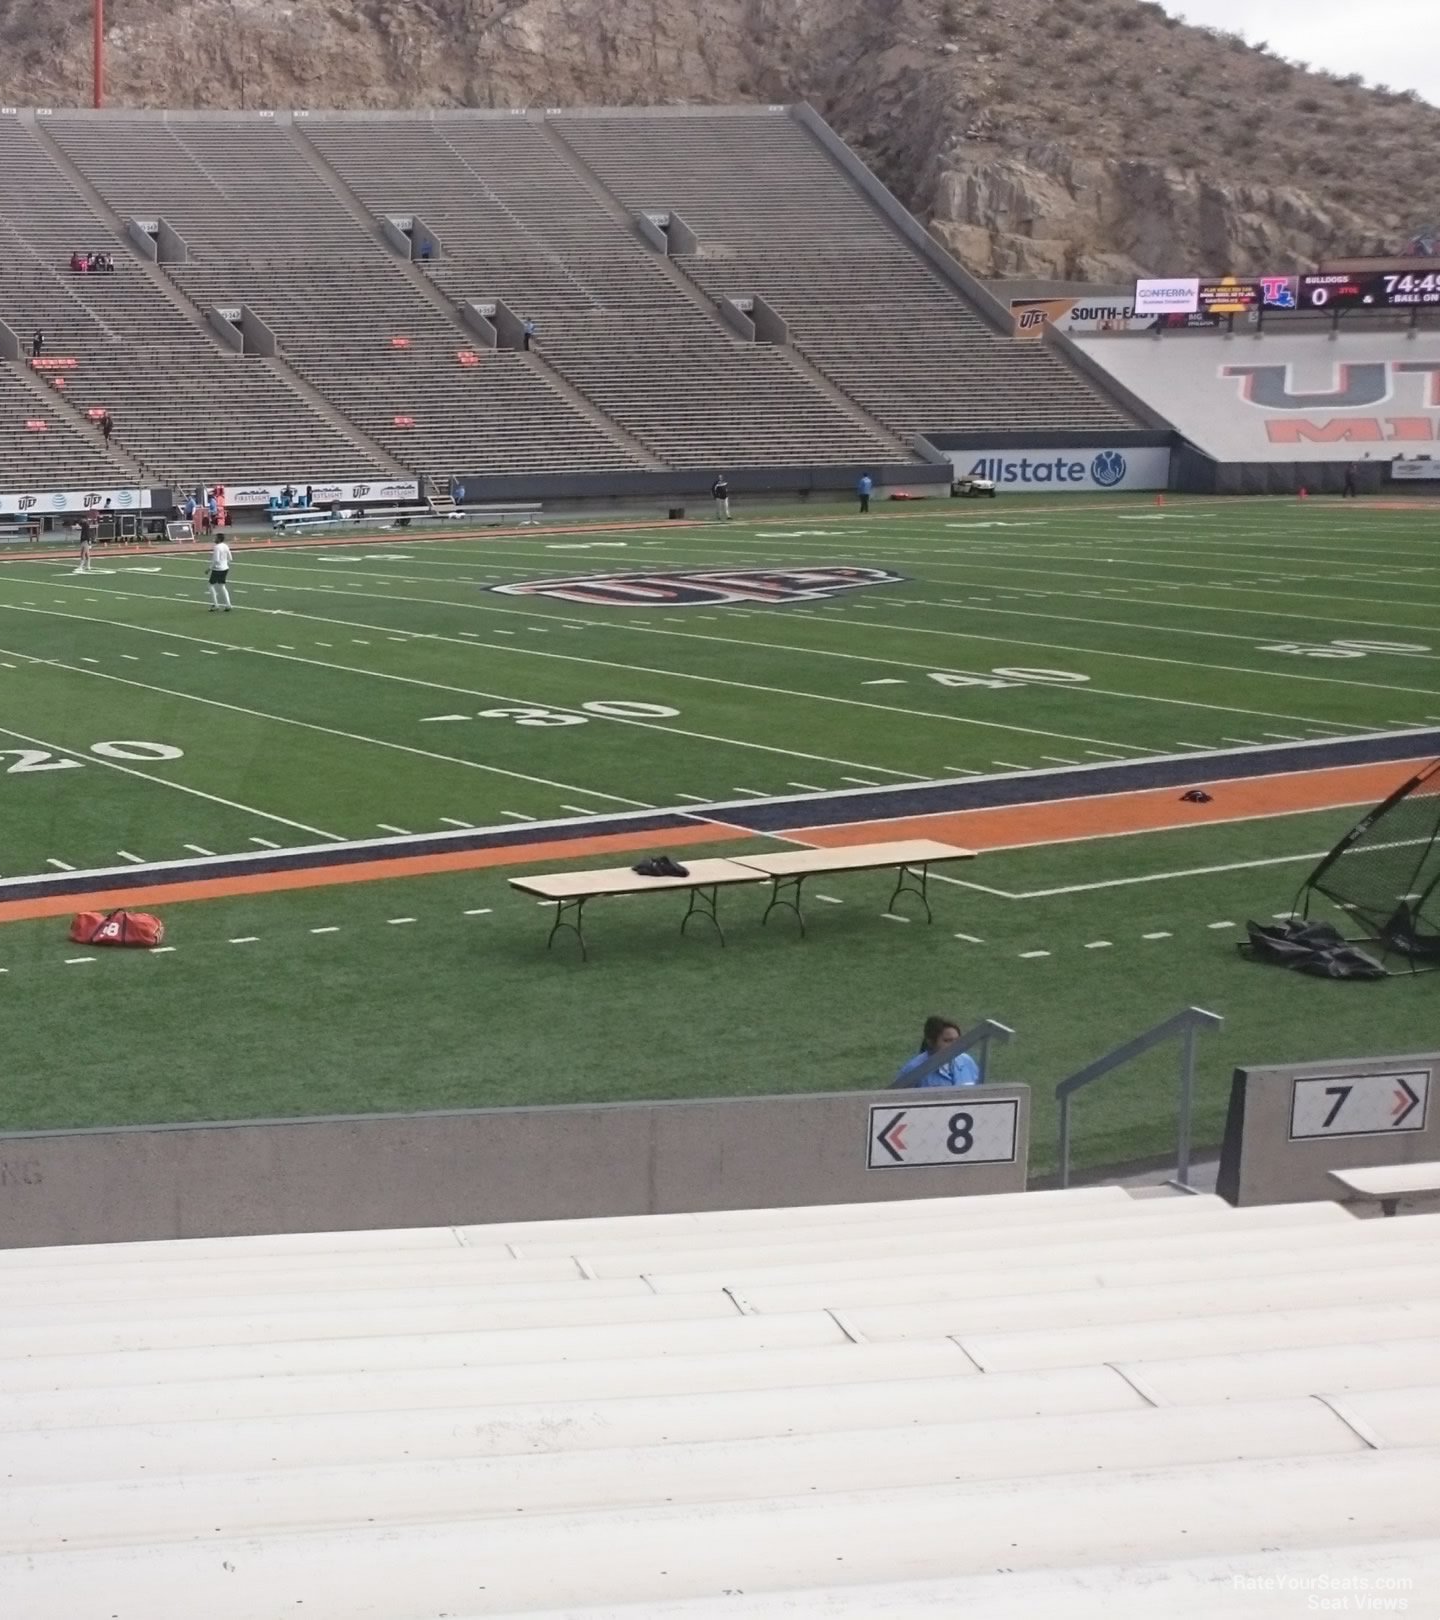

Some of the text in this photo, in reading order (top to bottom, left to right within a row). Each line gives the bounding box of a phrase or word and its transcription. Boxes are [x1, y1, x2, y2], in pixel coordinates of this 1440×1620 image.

[1305, 276, 1349, 284] BULLDOGS
[1311, 288, 1328, 305] 0
[1423, 294, 1440, 302] ON
[968, 458, 1086, 483] Allstate
[18, 495, 37, 511] UTEP
[83, 493, 102, 508] UTEP
[1254, 640, 1432, 657] 50
[926, 667, 1091, 689] 40
[477, 700, 681, 726] 30
[1322, 1086, 1353, 1128] 7
[946, 1112, 974, 1155] 8
